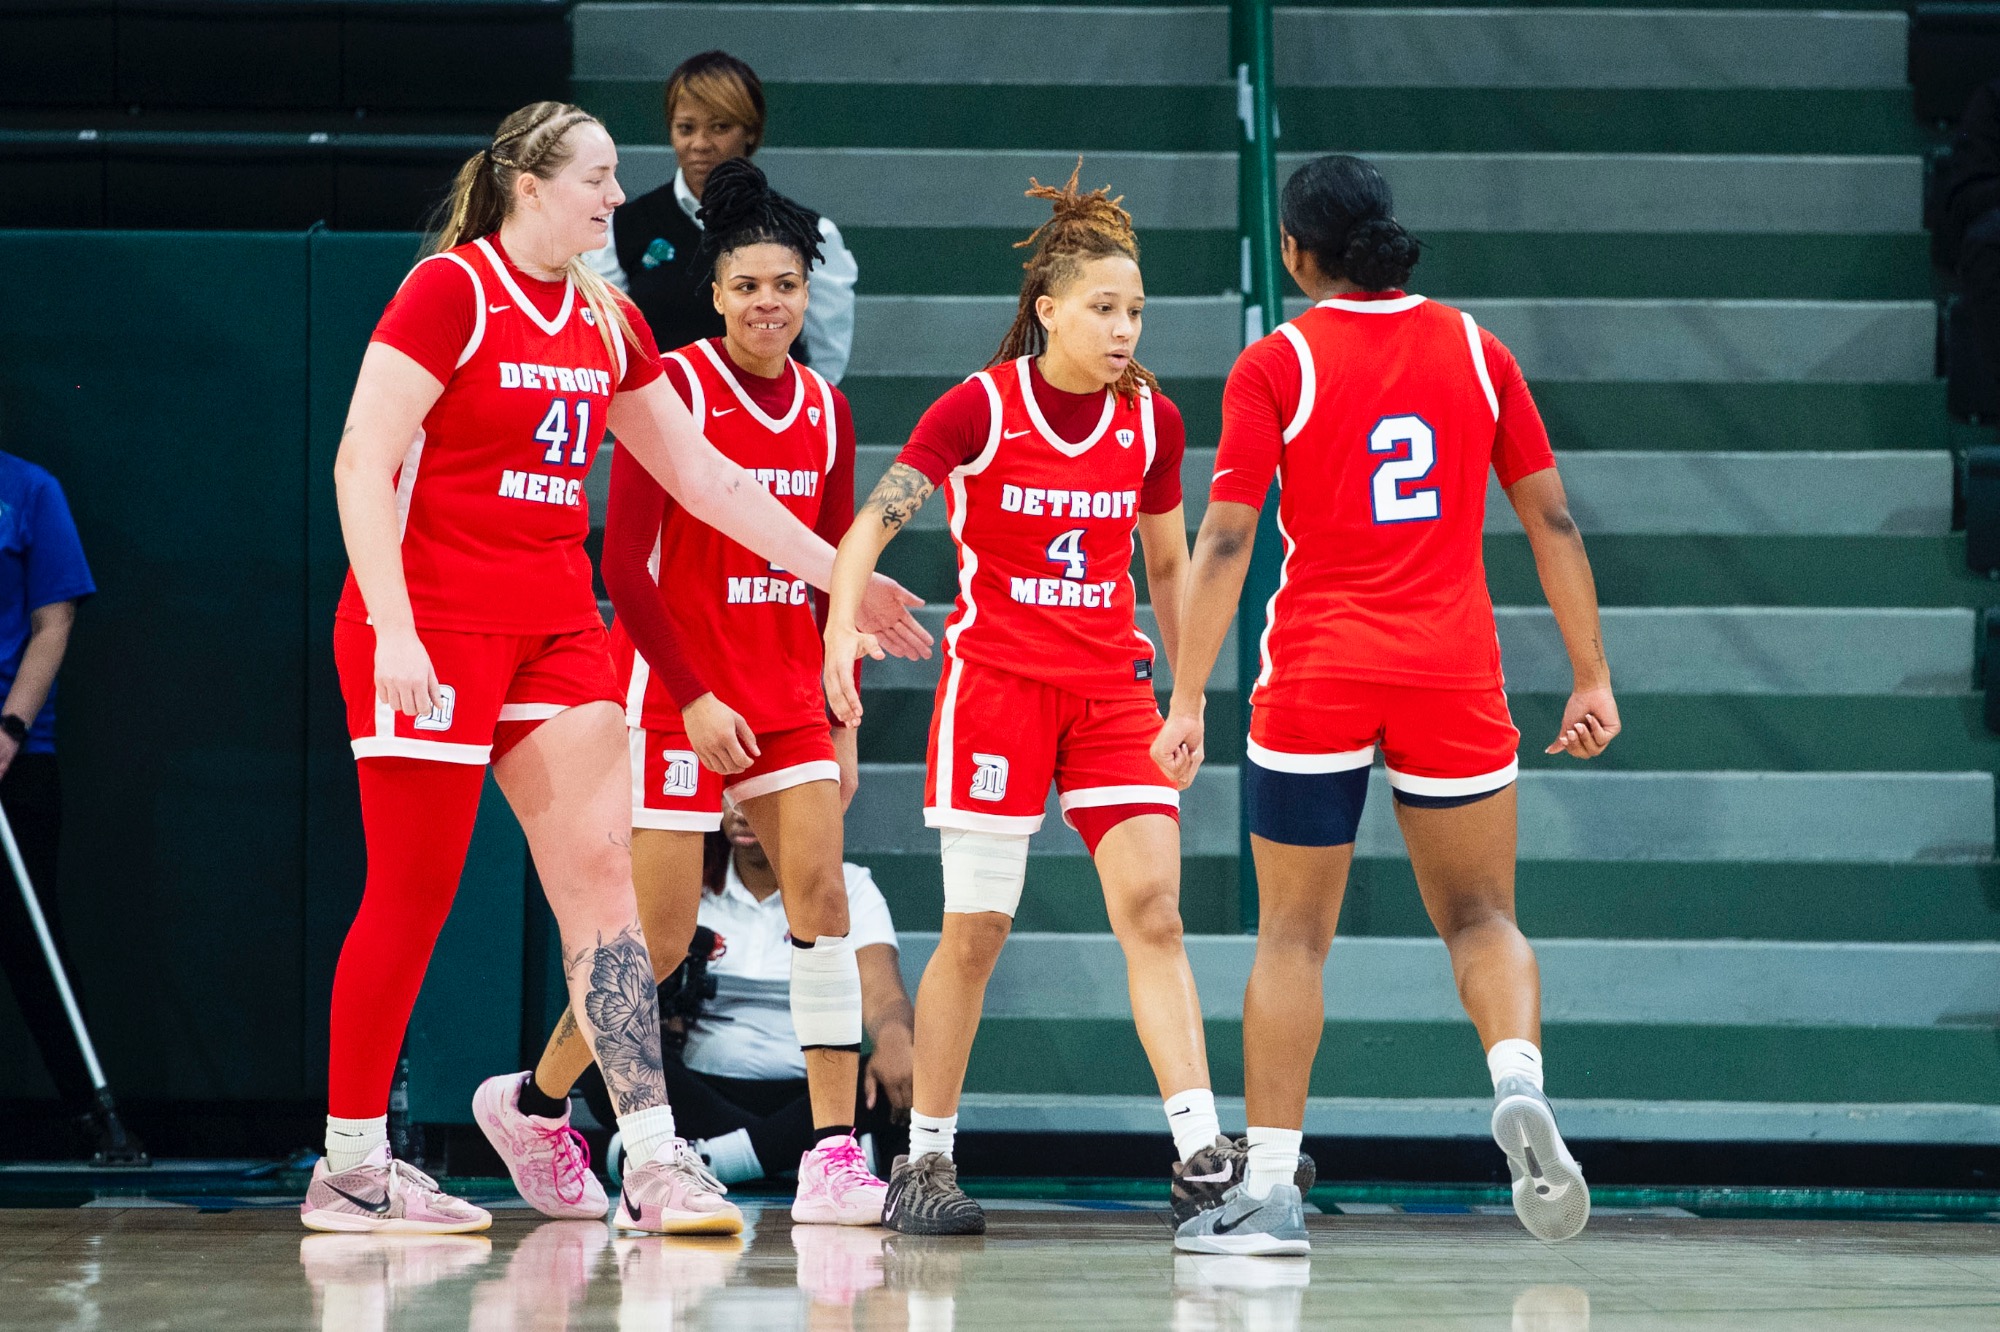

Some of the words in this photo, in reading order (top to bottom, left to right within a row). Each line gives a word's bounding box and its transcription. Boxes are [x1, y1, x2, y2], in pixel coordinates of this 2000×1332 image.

[499, 361, 610, 397] DETROIT
[533, 397, 591, 466] 41
[744, 468, 819, 497] TROIT
[1367, 412, 1442, 525] 2
[498, 469, 582, 506] MERC
[1001, 484, 1137, 518] DETROIT
[1045, 528, 1088, 580] 4
[727, 576, 806, 605] MERC
[1010, 577, 1117, 608] MERCY
